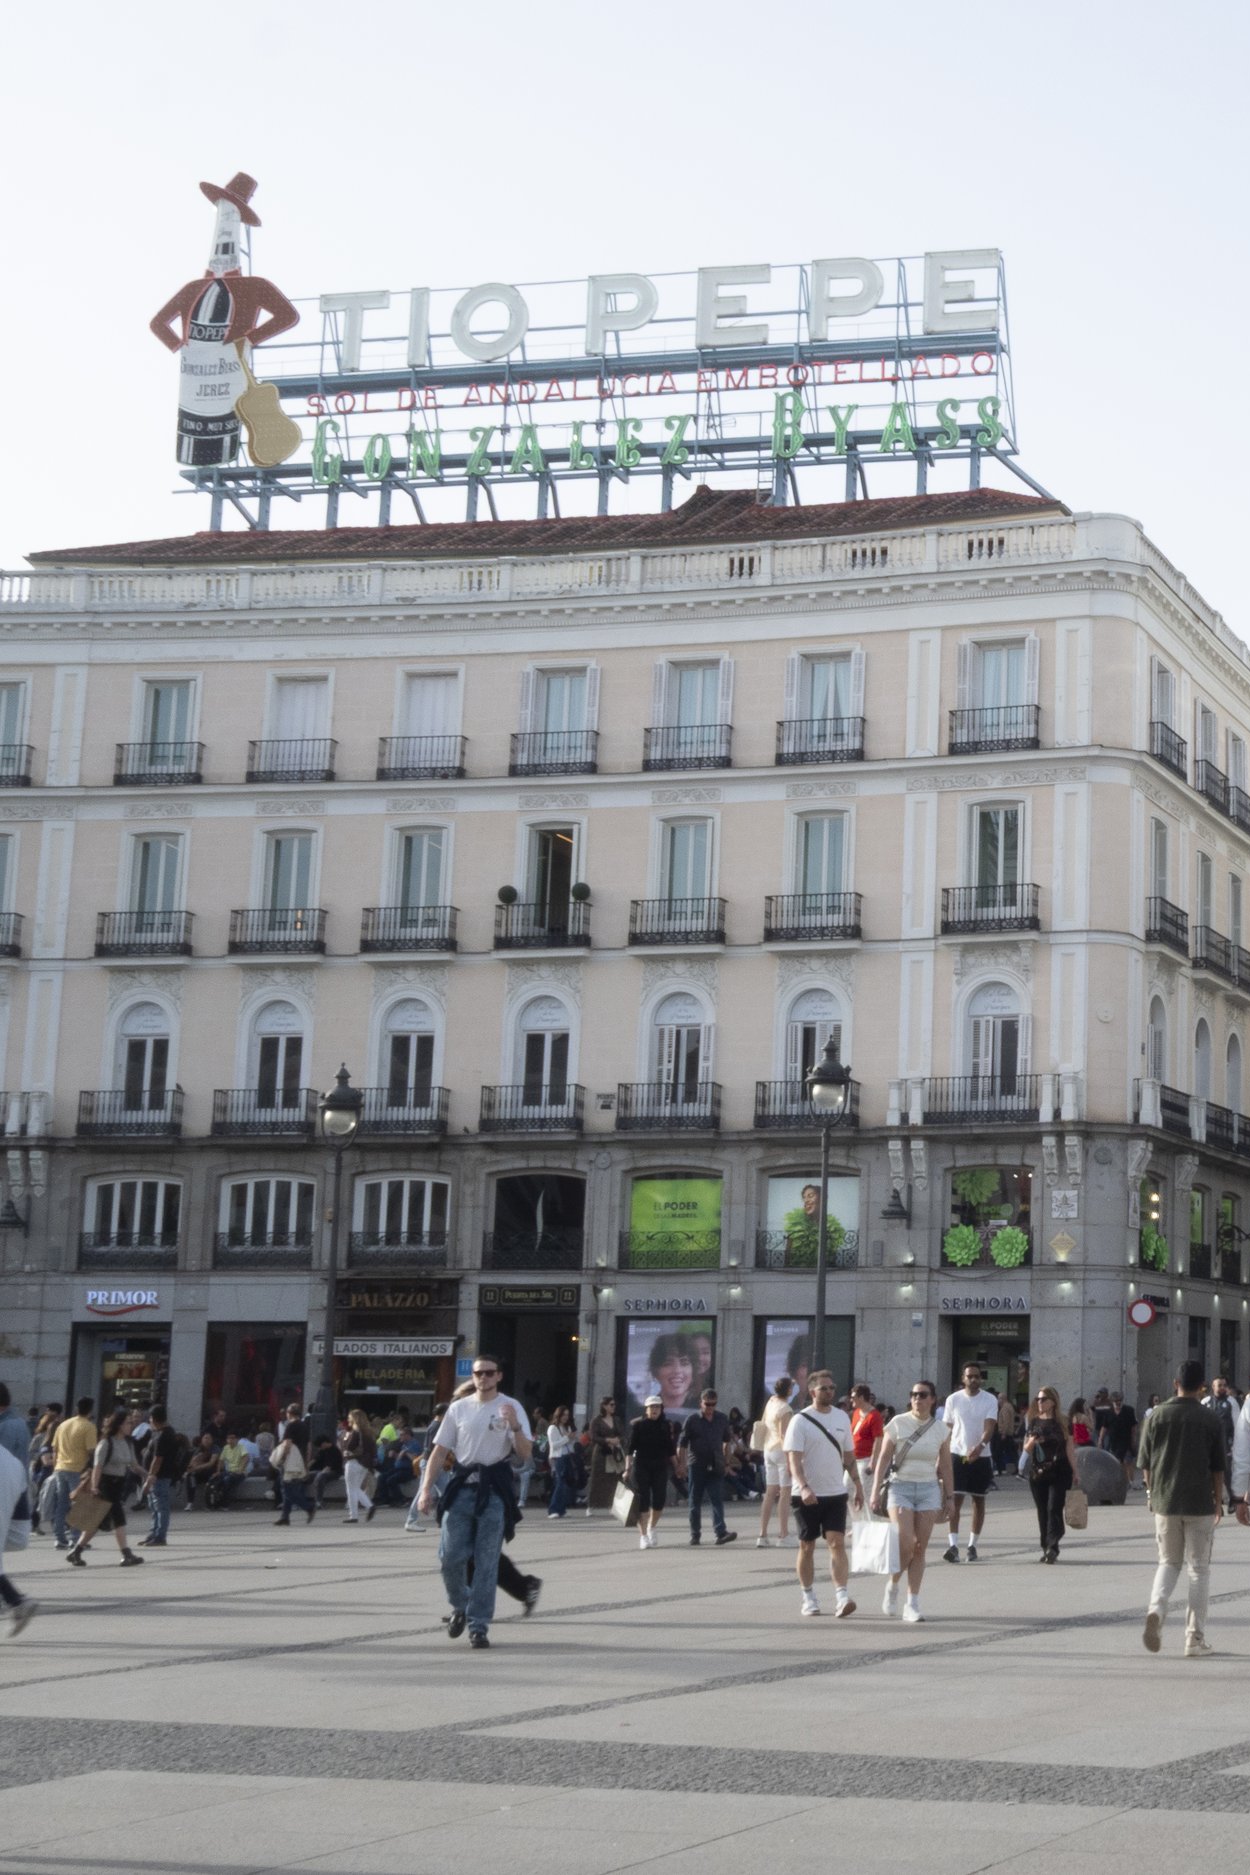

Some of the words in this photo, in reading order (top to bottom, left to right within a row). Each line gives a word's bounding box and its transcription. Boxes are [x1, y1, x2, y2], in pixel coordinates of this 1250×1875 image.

[320, 282, 529, 372] TIO
[585, 248, 1000, 356] PEPE
[306, 391, 383, 417] SOL
[398, 384, 445, 412] DE
[462, 370, 680, 406] ANDALUCIA
[697, 351, 995, 394] EMBOTELLADO
[664, 1201, 698, 1211] PODER
[86, 1290, 159, 1305] PRIMOR
[351, 1292, 430, 1309] PALAZZO
[942, 1297, 1027, 1310] SEPHORA
[624, 1298, 708, 1312] SEPHORA
[318, 1343, 377, 1354] HLADOS
[383, 1343, 448, 1355] ITALIANOS
[354, 1368, 426, 1380] HELADERIA
